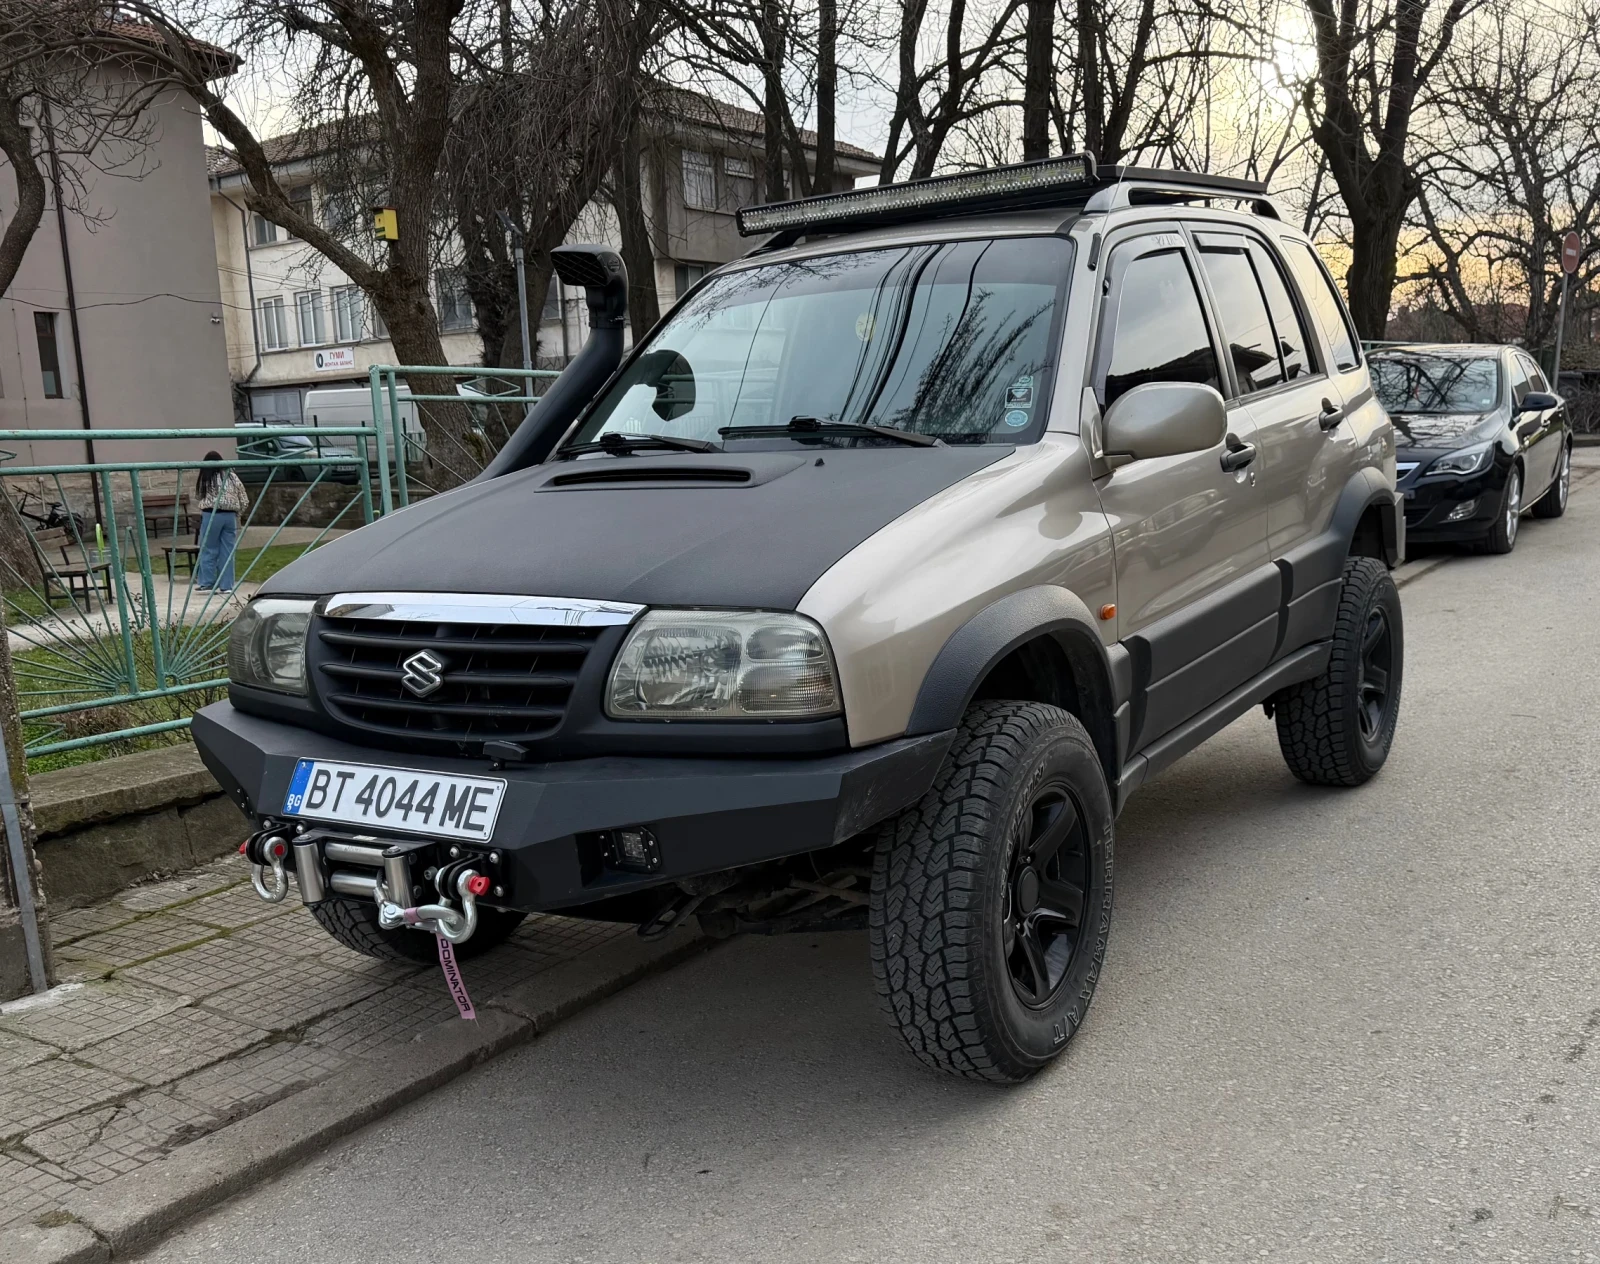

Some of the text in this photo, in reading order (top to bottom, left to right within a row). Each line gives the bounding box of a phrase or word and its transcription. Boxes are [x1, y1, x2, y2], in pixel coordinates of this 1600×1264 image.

[329, 351, 345, 360] ГУМИ
[286, 793, 302, 807] BG
[305, 769, 494, 832] BT 4044 ME
[1053, 816, 1115, 1044] TERRAMAX A/T
[441, 938, 471, 1012] DOMINATOR
